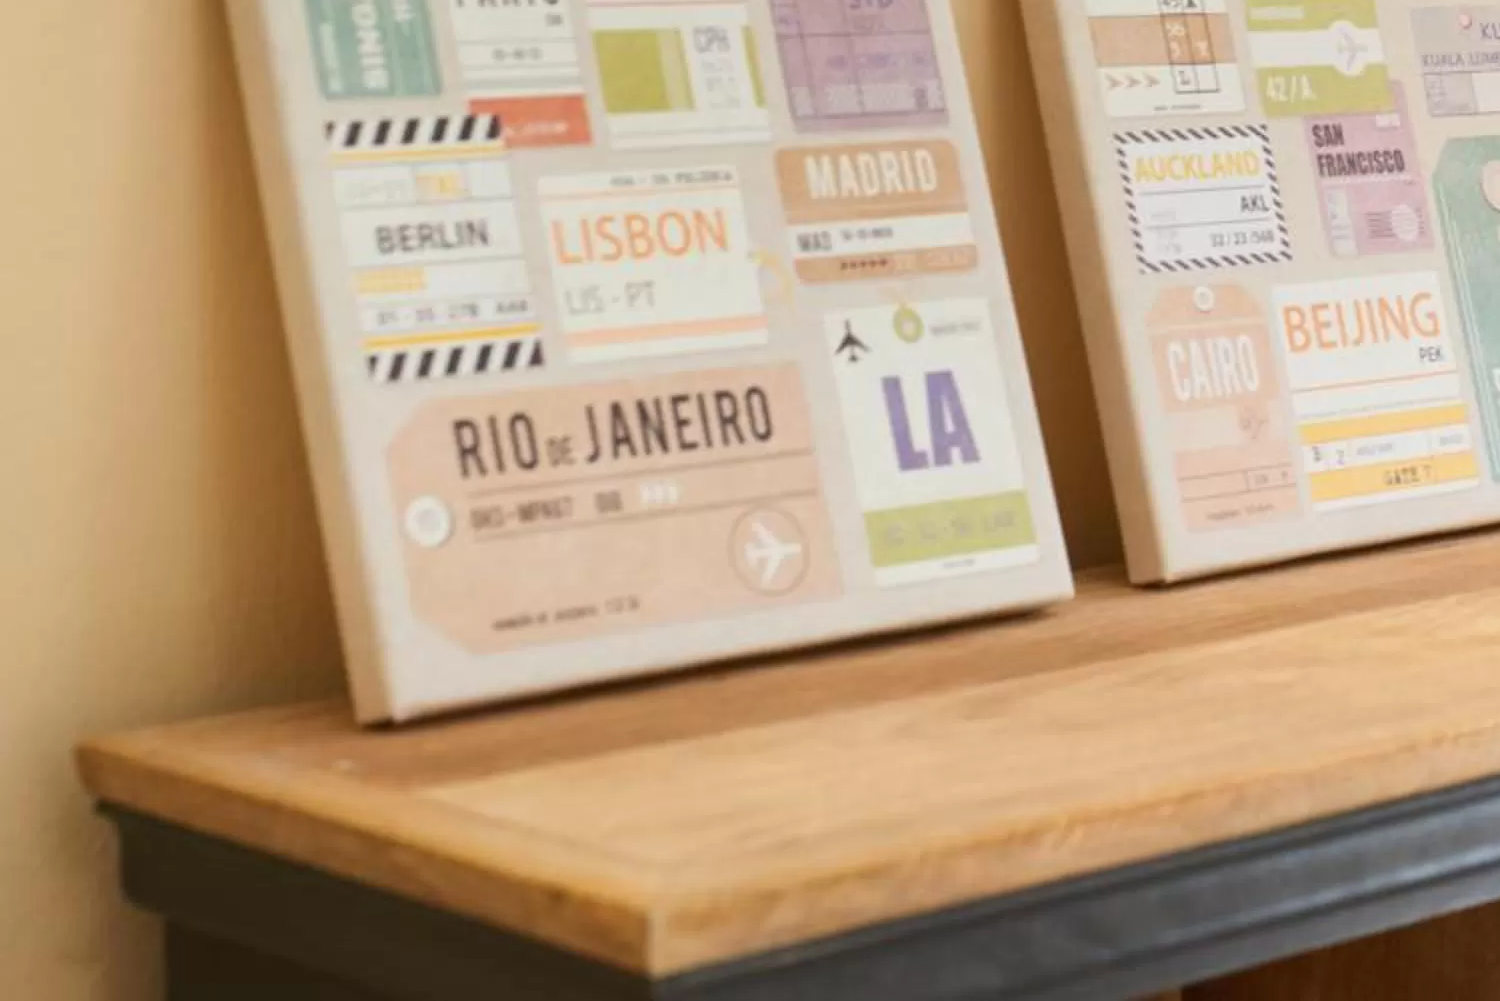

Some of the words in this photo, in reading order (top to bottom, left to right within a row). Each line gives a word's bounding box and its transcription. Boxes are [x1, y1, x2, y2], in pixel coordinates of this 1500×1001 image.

[1311, 122, 1345, 148] SAN
[806, 149, 938, 199] MADRID
[1134, 151, 1260, 183] AUCKLAND
[1316, 148, 1405, 179] FRANCISCO
[1239, 195, 1271, 213] AKL
[375, 218, 491, 255] BERLIN
[550, 208, 728, 265] LISBON
[1282, 291, 1442, 352] BEIJING
[1166, 334, 1261, 402] CAIRO
[453, 411, 540, 479] RIO
[584, 386, 774, 465] JANEIRO
[881, 368, 981, 472] LA
